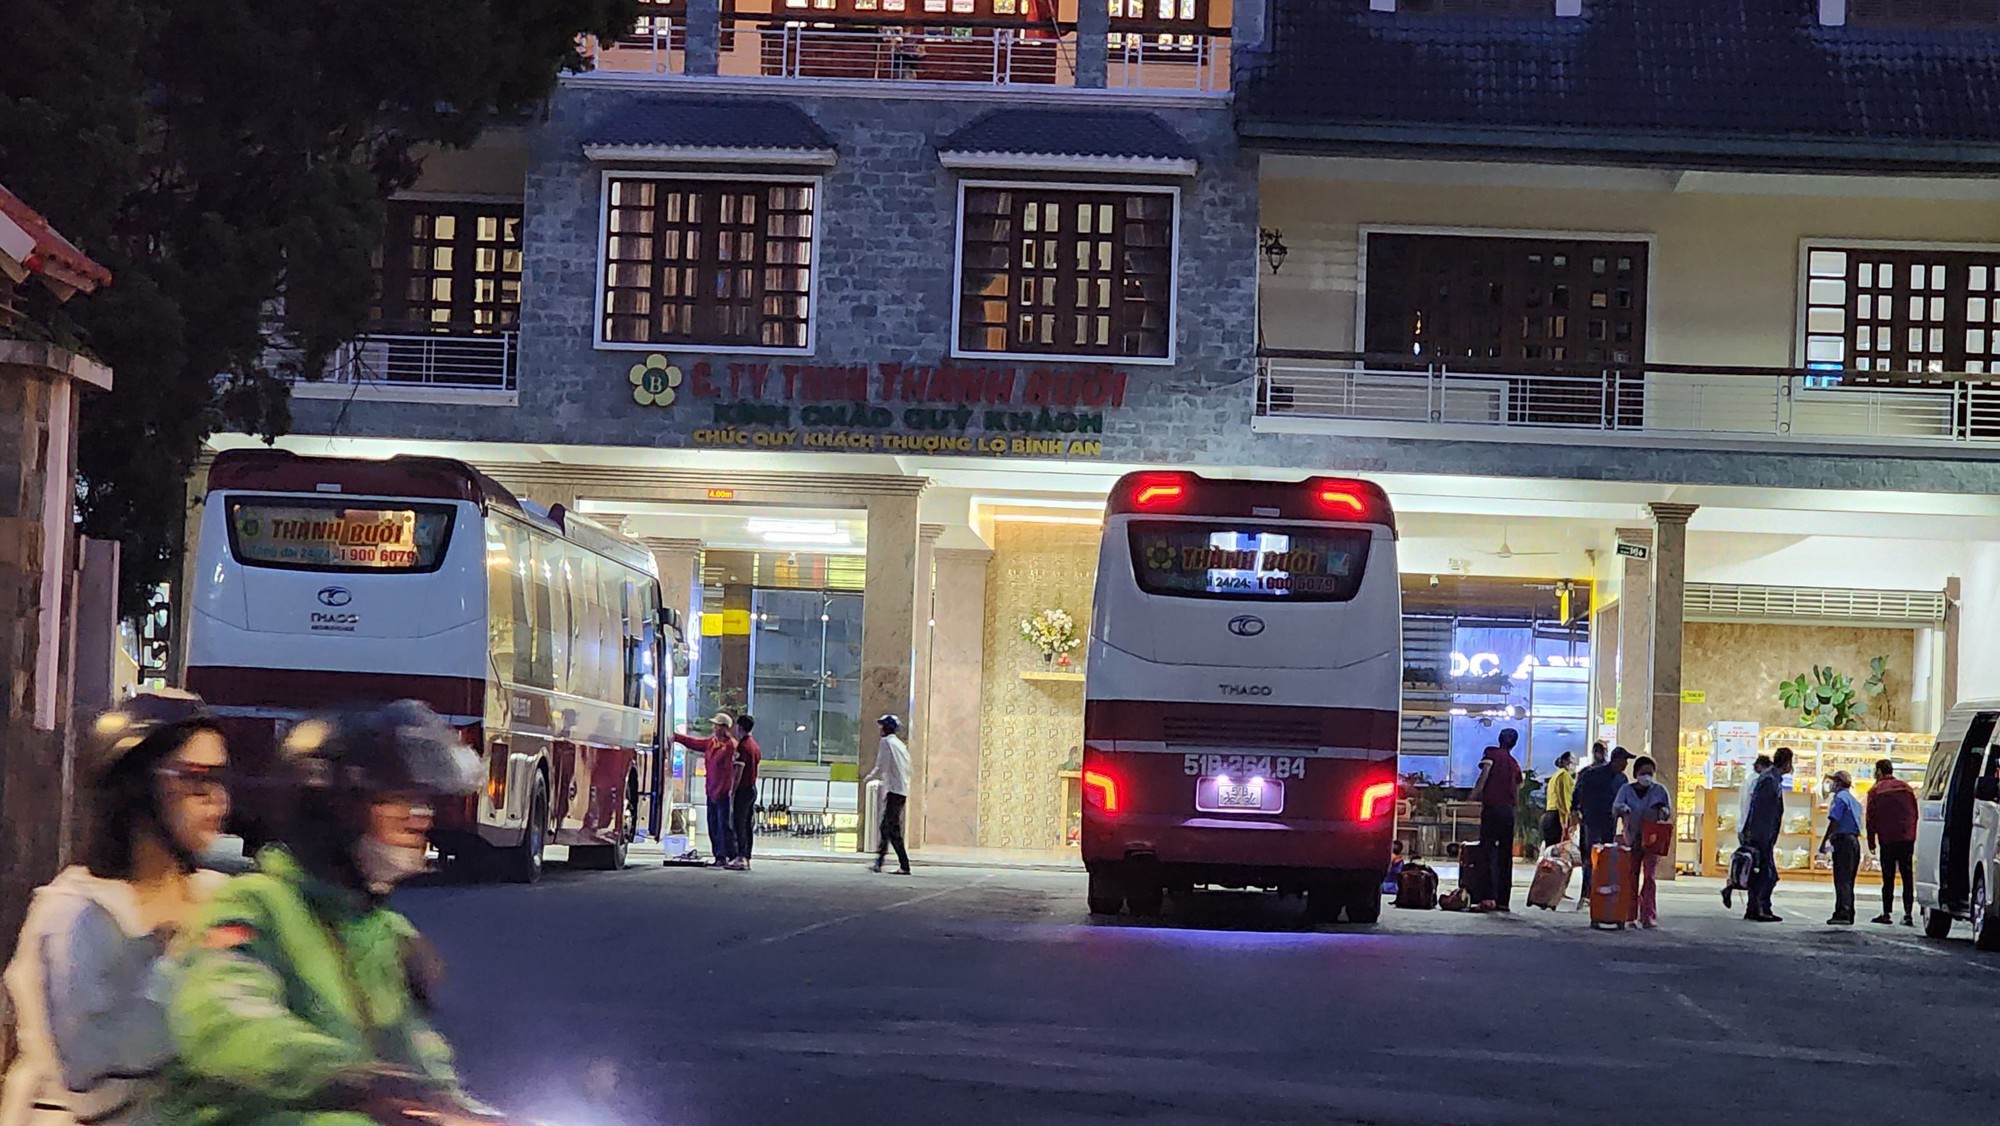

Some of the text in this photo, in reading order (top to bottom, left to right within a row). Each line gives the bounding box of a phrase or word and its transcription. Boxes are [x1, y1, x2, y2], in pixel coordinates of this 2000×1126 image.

[727, 362, 769, 399] TY
[783, 363, 868, 402] TNHH
[692, 424, 749, 446] CHÚC
[803, 428, 875, 449] KHÁCH
[881, 433, 975, 456] THƯỢNG
[1011, 436, 1065, 455] BÌNH
[1068, 441, 1102, 457] AN
[709, 490, 733, 499] 4.00m
[272, 517, 404, 545] THÀNH BƯỞI
[379, 550, 416, 563] 6079
[1182, 545, 1259, 571] THÀNH
[311, 613, 360, 624] THACO
[1219, 684, 1273, 697] THACO
